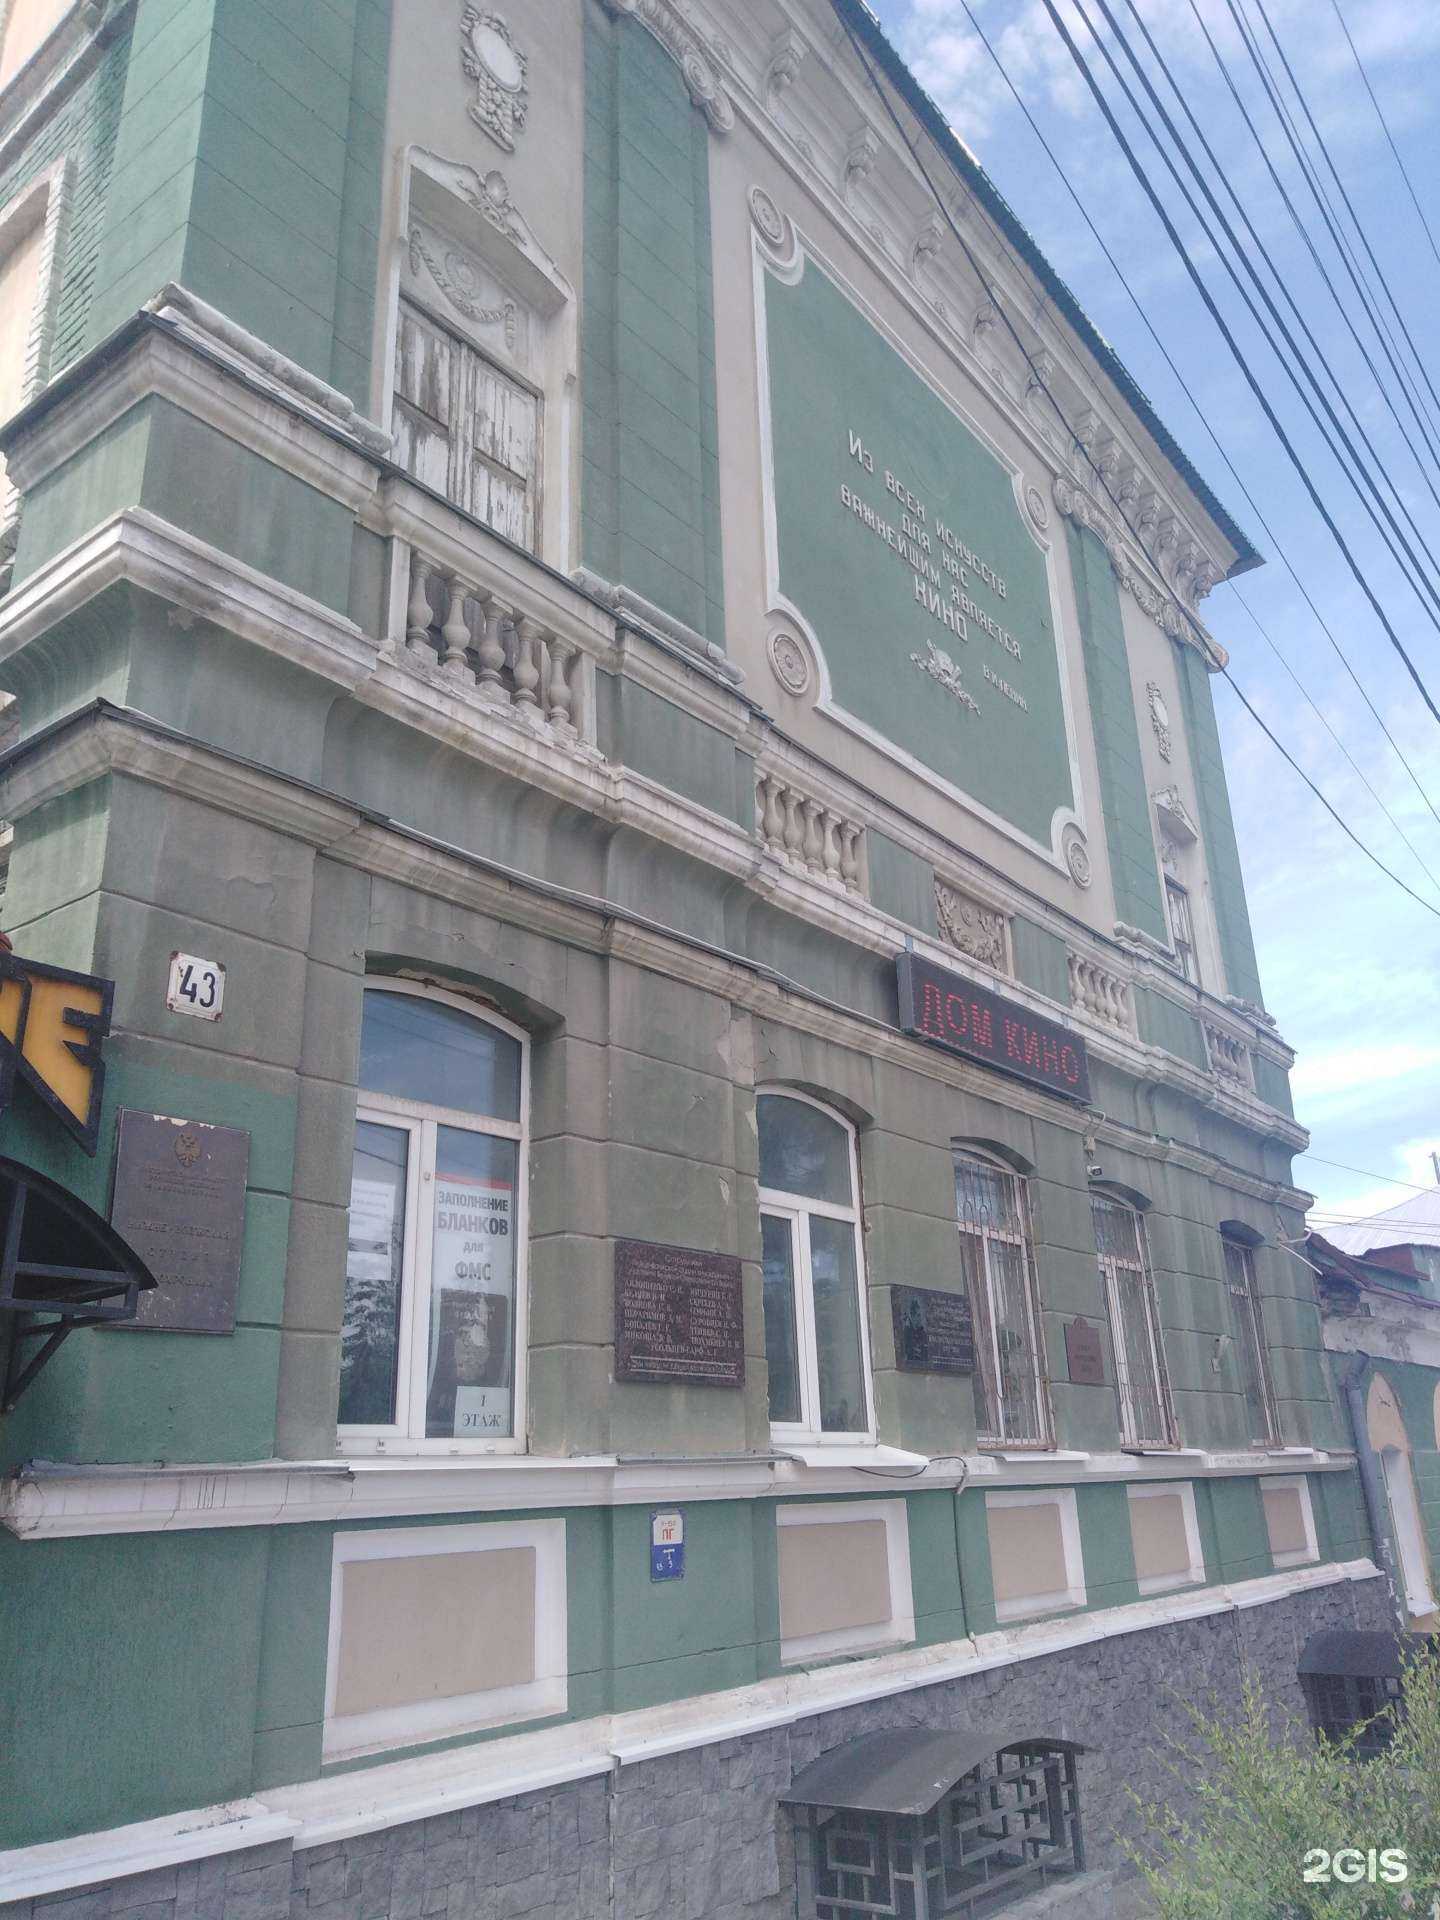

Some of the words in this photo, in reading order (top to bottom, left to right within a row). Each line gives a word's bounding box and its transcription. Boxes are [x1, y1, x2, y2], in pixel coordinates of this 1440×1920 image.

[902, 513, 931, 554] ДЛЯ
[942, 549, 969, 588] НАС
[936, 518, 1007, 599] ИСКУССТВ
[914, 574, 968, 641] КИНО
[952, 584, 1022, 663] ЯВЛЯЕТСЯ
[179, 964, 216, 1008] 43
[918, 981, 993, 1048] ДОМ
[438, 1190, 509, 1212] ЗАПОЛНЕНИЕ
[438, 1211, 509, 1236] БЛАНКОВ
[455, 1261, 491, 1280] ФМС
[463, 1413, 503, 1427] ЭТАЖ
